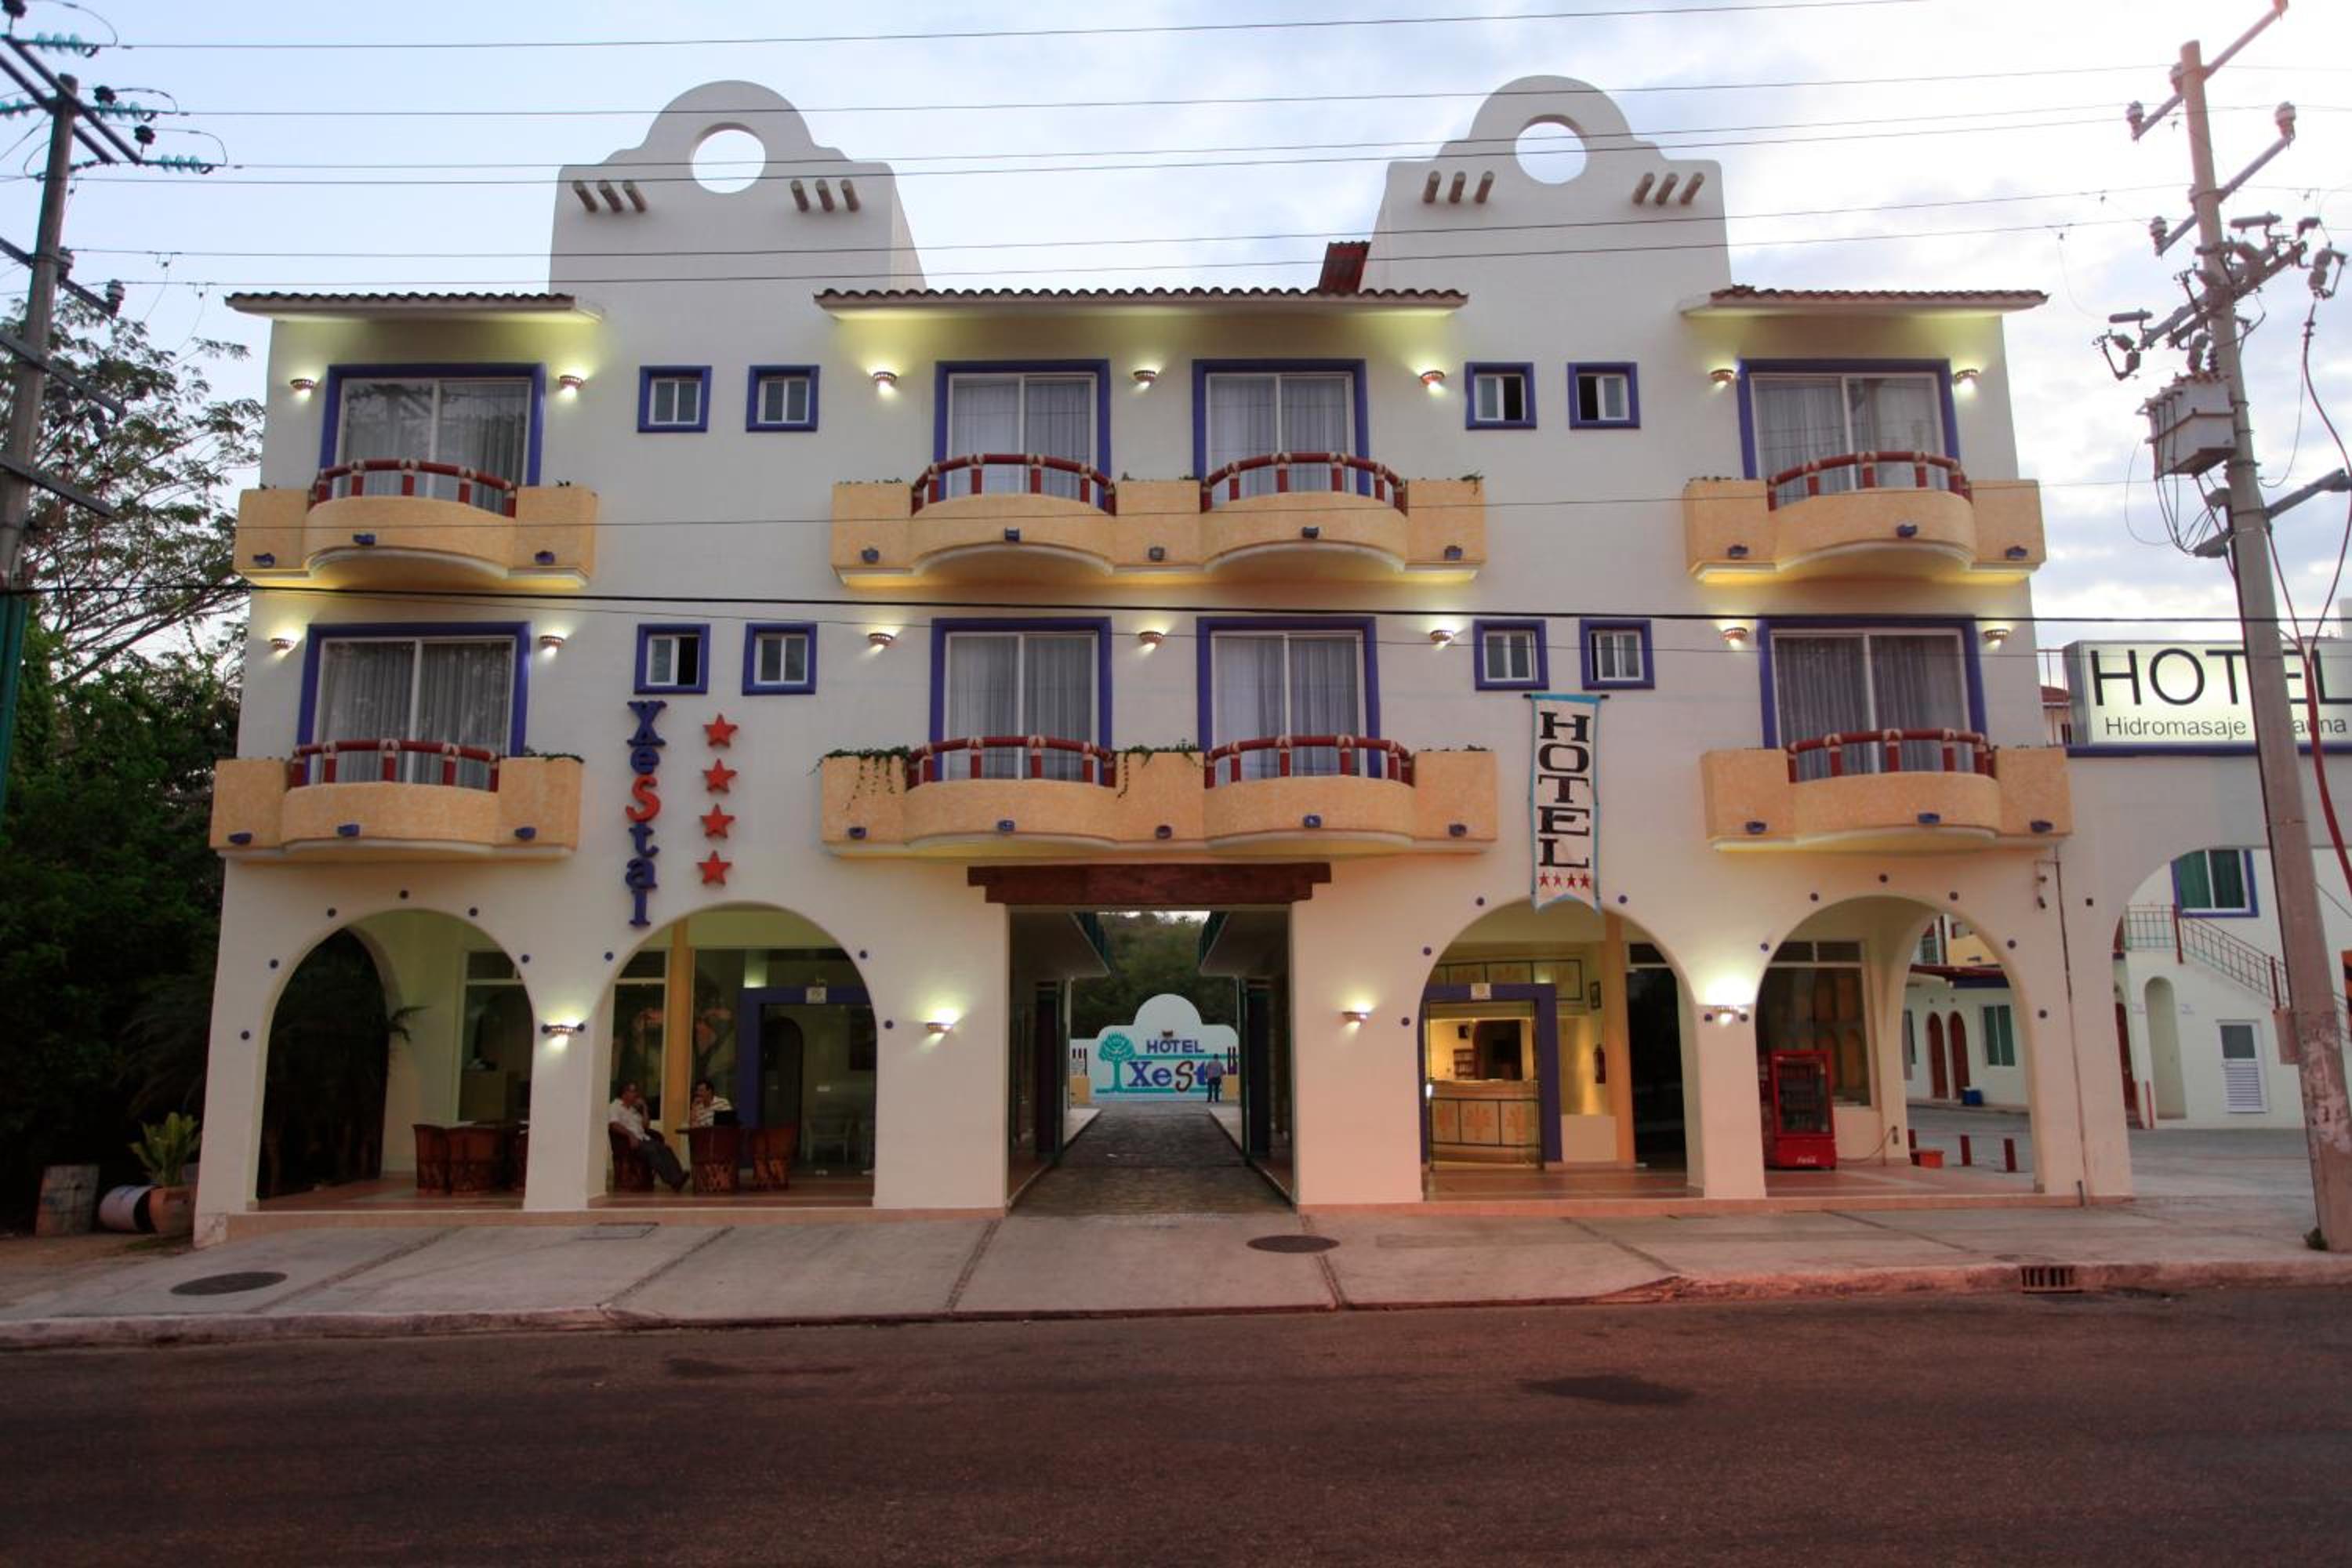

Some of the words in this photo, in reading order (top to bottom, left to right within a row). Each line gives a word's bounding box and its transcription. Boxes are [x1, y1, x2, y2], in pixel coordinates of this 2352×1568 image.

[2105, 717, 2246, 739] Hidromasaje
[2289, 718, 2347, 733] ana
[1537, 711, 1591, 869] HOTEL
[1146, 1040, 1205, 1054] HOTEL
